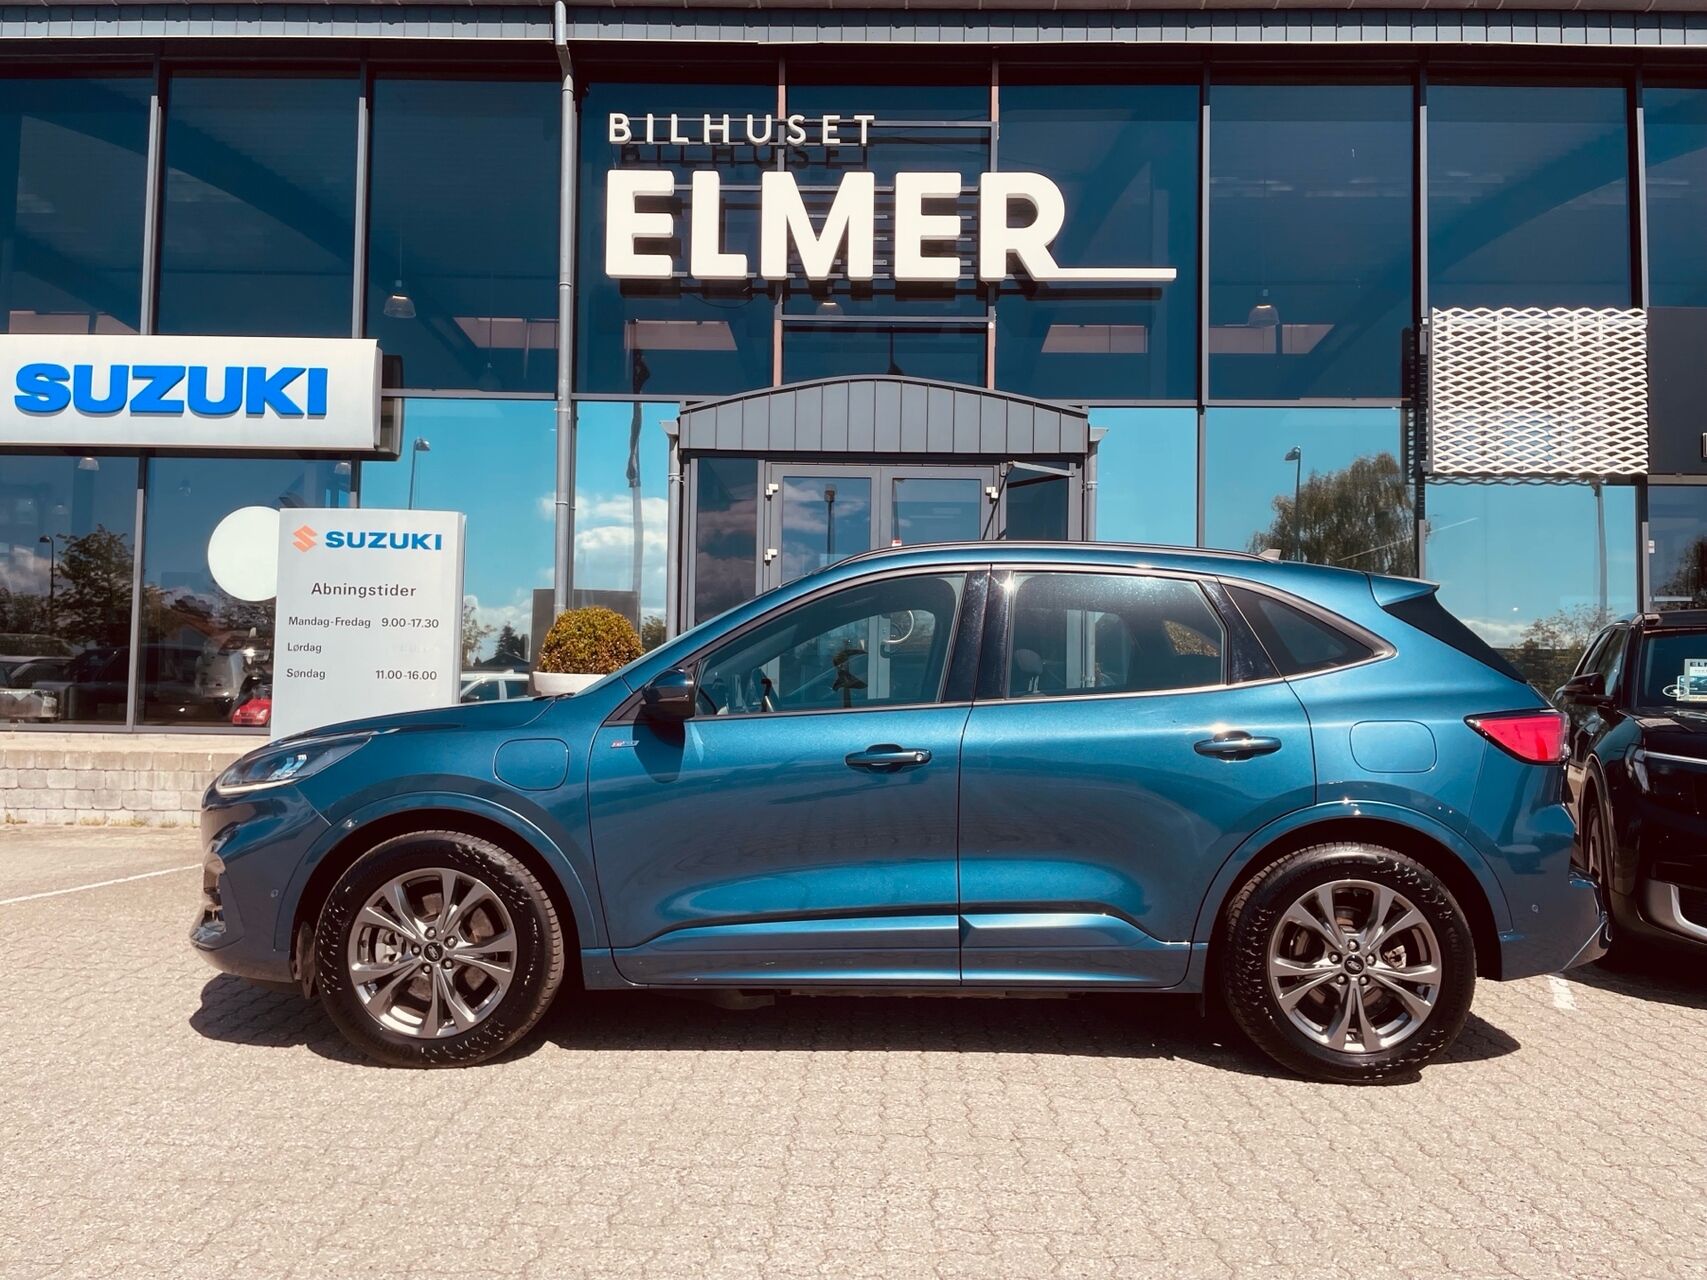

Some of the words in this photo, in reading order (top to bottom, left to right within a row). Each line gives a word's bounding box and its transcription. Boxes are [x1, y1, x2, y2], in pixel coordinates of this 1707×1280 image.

[608, 112, 876, 146] BILHUSET
[605, 169, 1177, 283] ELMER
[14, 363, 328, 417] SUZUKI
[325, 531, 442, 550] SUZUKI
[288, 616, 371, 628] Mandag-Fredag
[287, 642, 322, 654] Lørdag
[286, 668, 326, 680] Søndag
